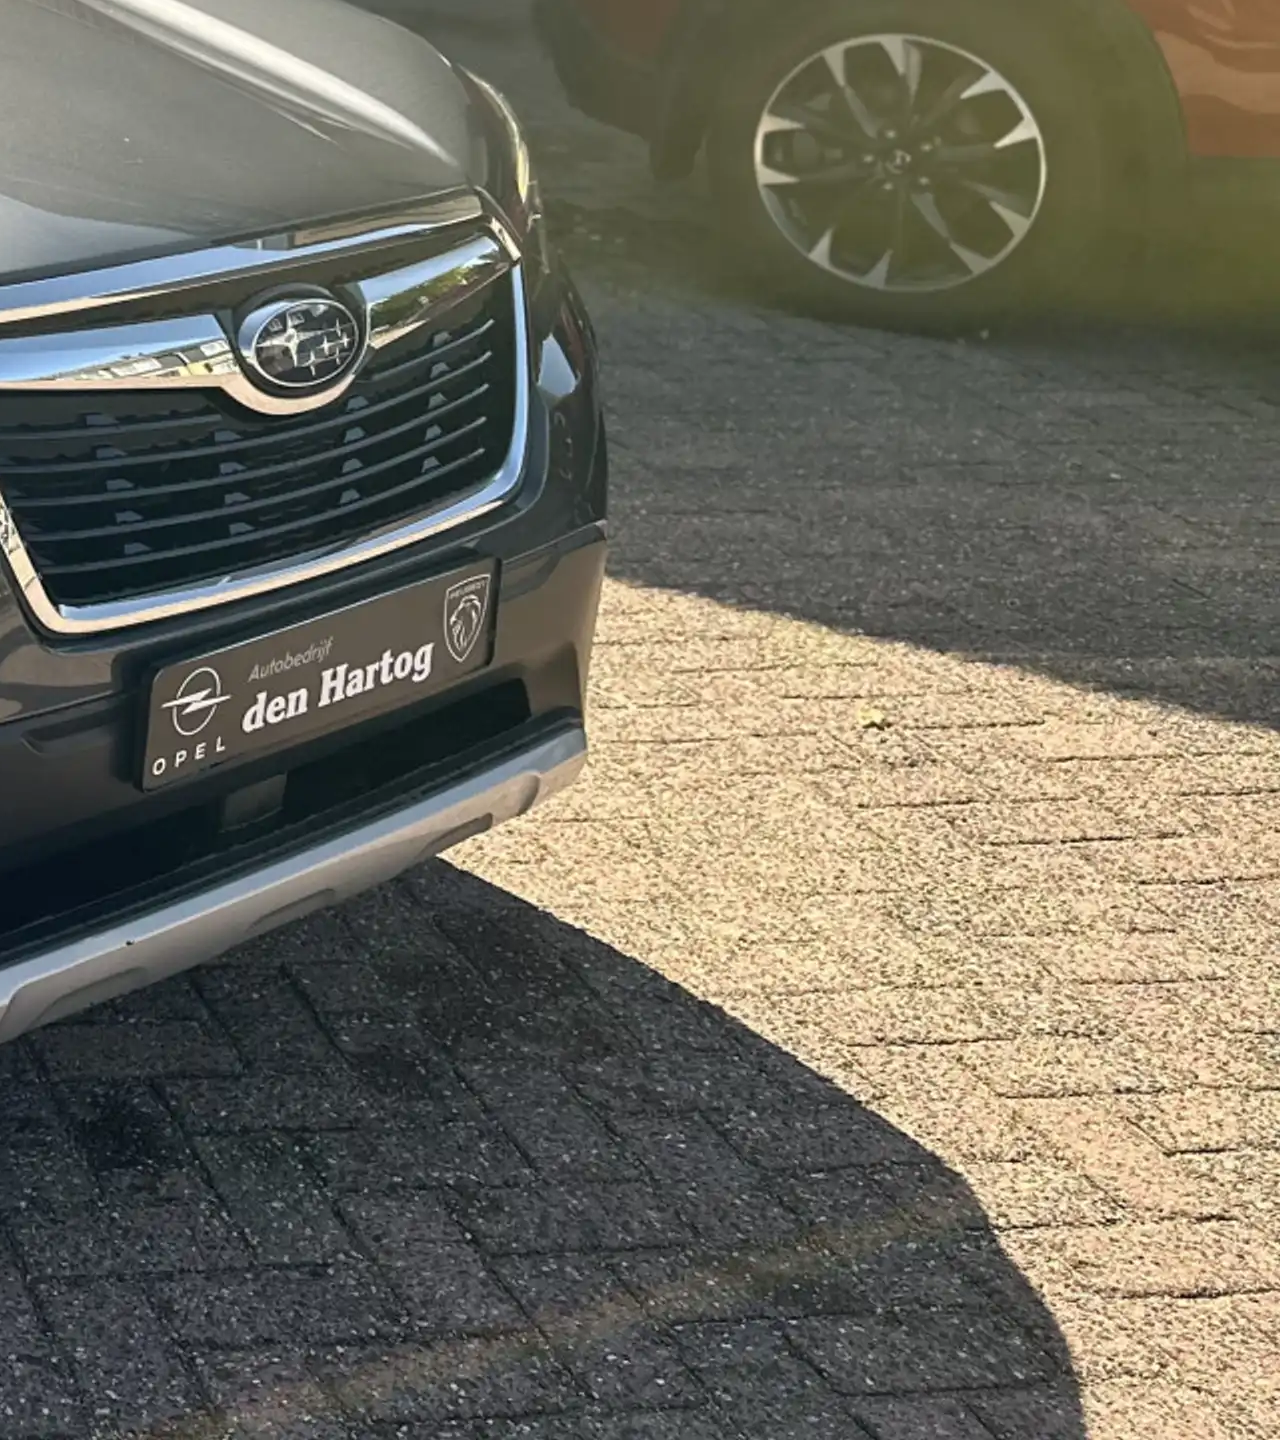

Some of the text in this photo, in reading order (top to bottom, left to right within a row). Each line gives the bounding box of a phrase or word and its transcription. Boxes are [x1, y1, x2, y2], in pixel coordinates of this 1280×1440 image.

[247, 636, 334, 683] Autobedrijf
[241, 641, 436, 733] den Hartog
[151, 735, 227, 776] OPEL
